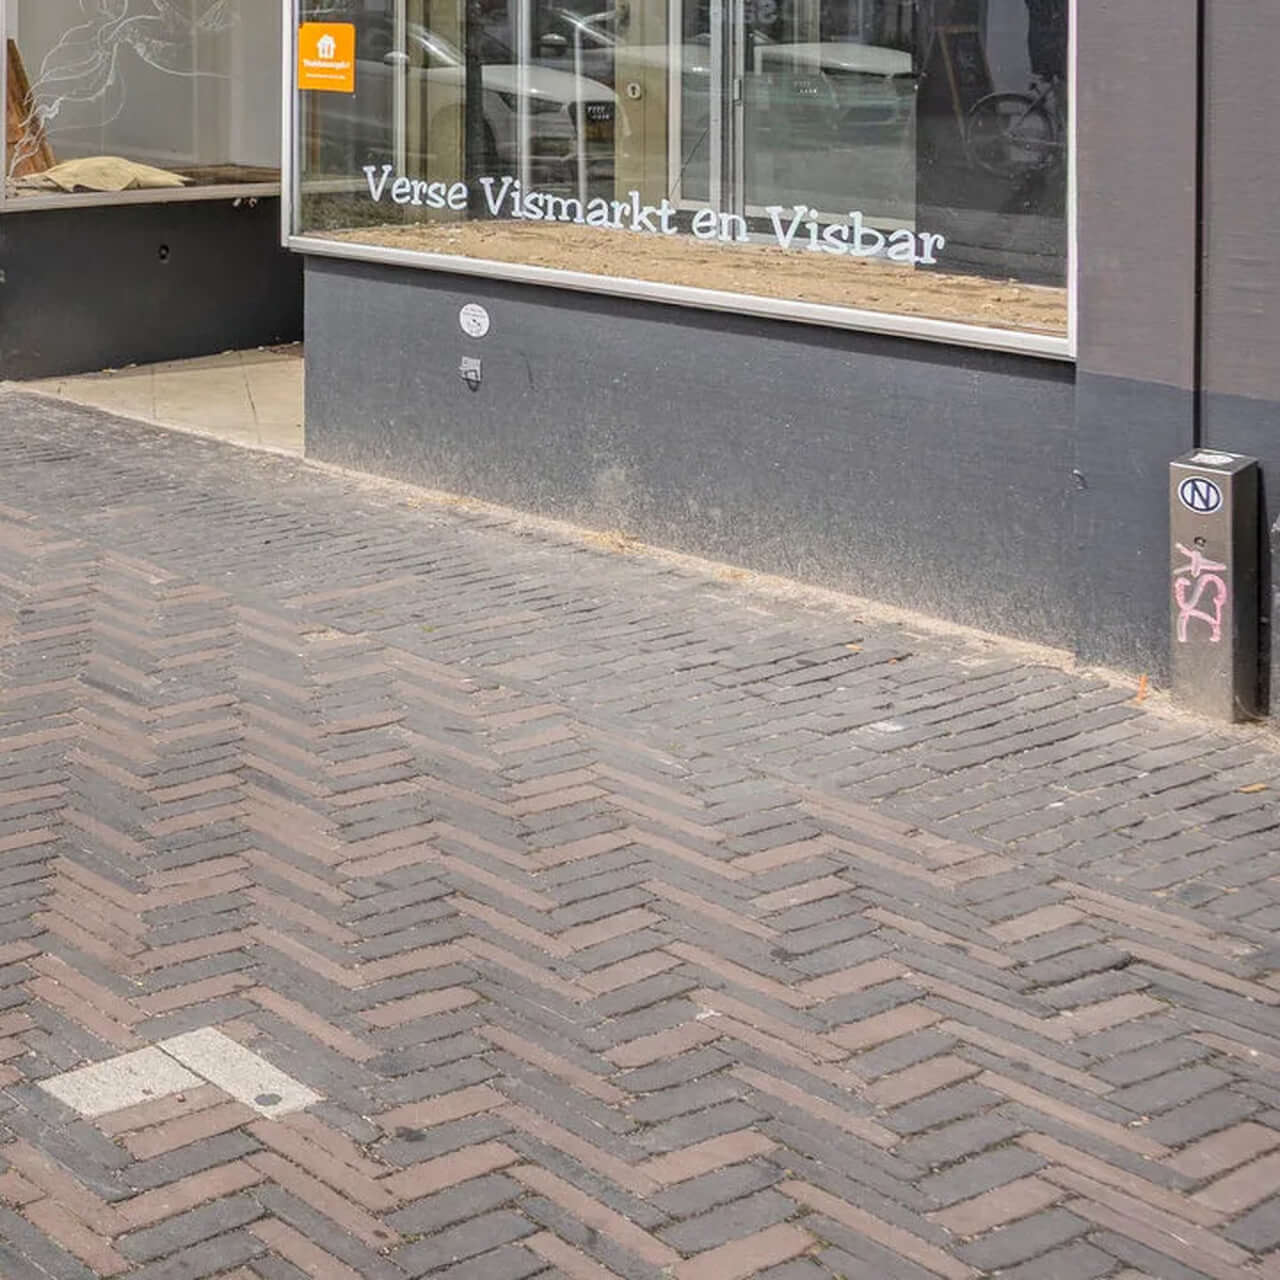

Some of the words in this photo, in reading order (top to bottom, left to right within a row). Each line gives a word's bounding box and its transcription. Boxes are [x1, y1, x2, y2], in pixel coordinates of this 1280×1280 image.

[363, 166, 468, 212] Verse
[480, 175, 677, 237] Vismarkt
[692, 209, 746, 243] en
[765, 206, 945, 265] Visbar
